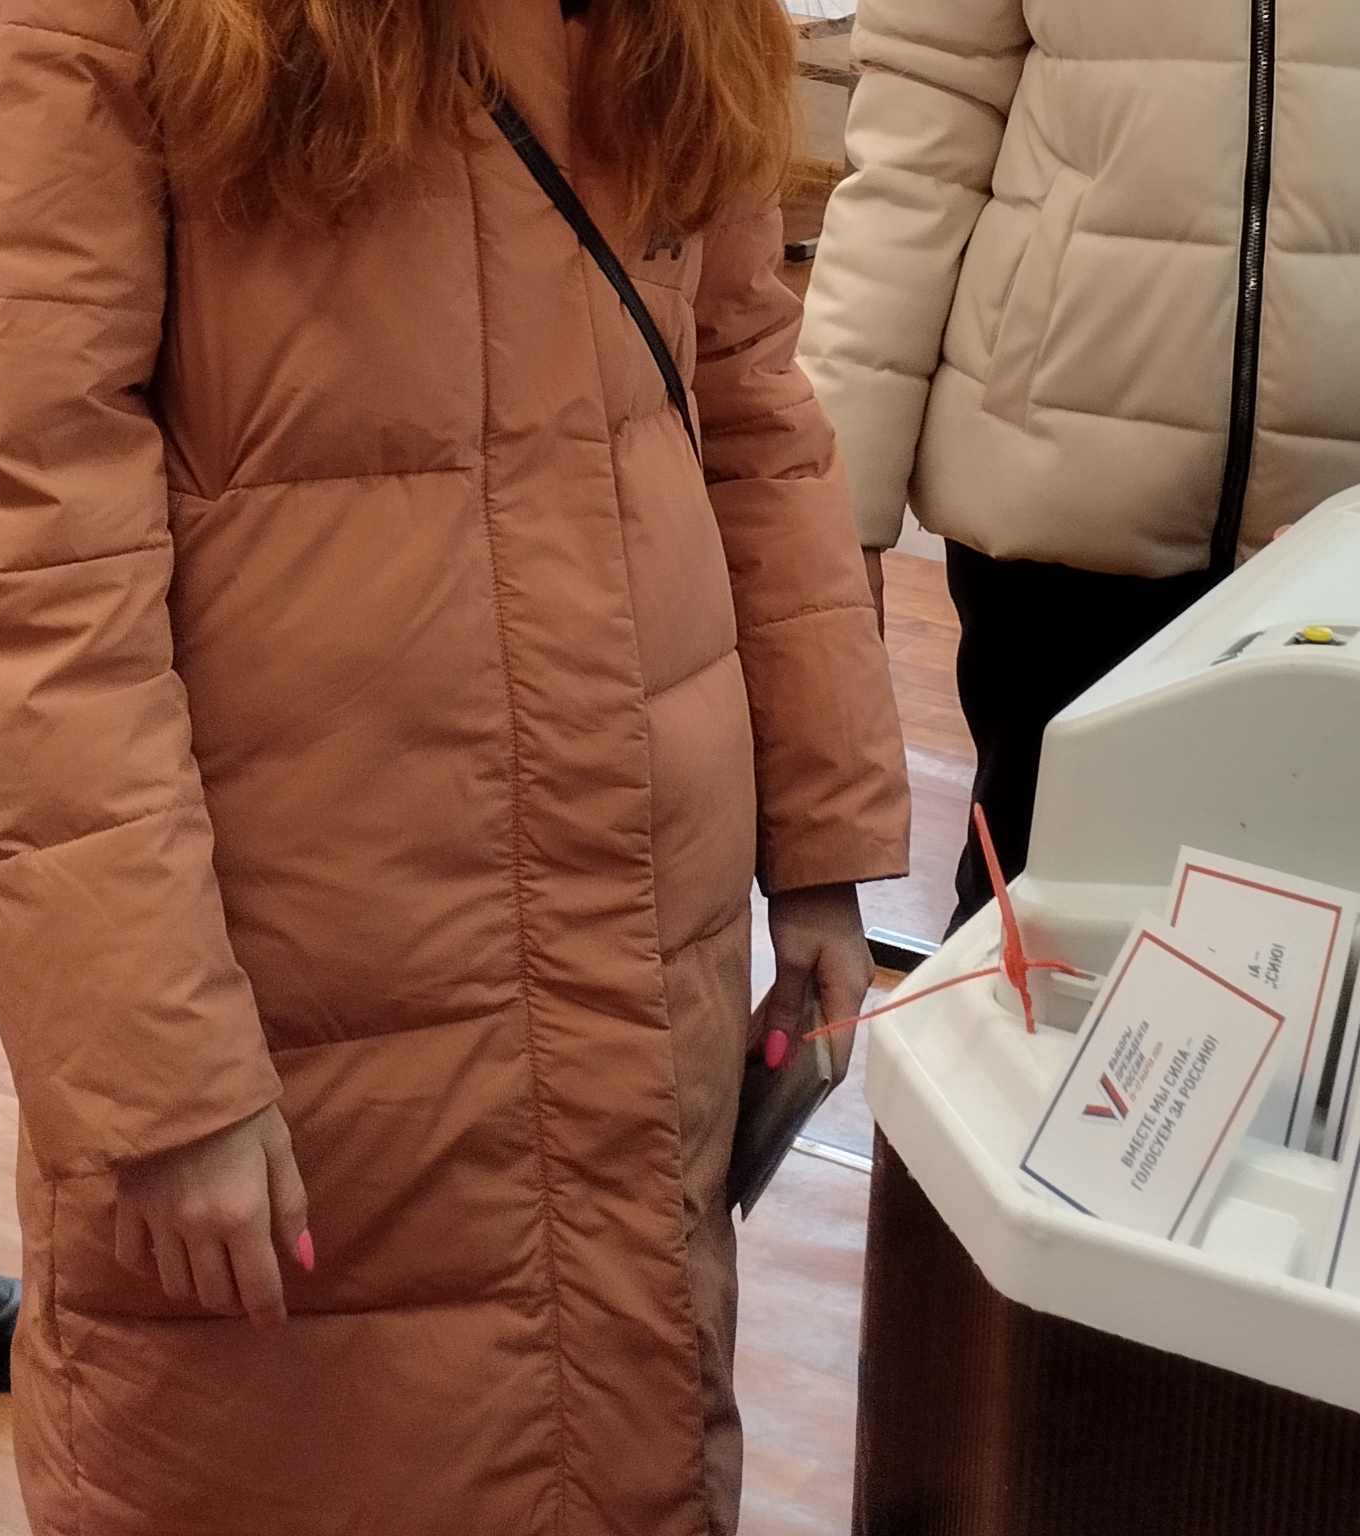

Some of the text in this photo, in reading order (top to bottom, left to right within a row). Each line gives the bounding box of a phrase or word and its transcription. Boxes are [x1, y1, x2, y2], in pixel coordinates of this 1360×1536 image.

[1120, 1112, 1156, 1169] ВМЕСТЕ
[1149, 1086, 1170, 1114] МЫ
[1164, 1049, 1190, 1087] СИЛА
[1130, 1034, 1220, 1192] ГОЛОСУЕМ ЗА РОССИЮ!
